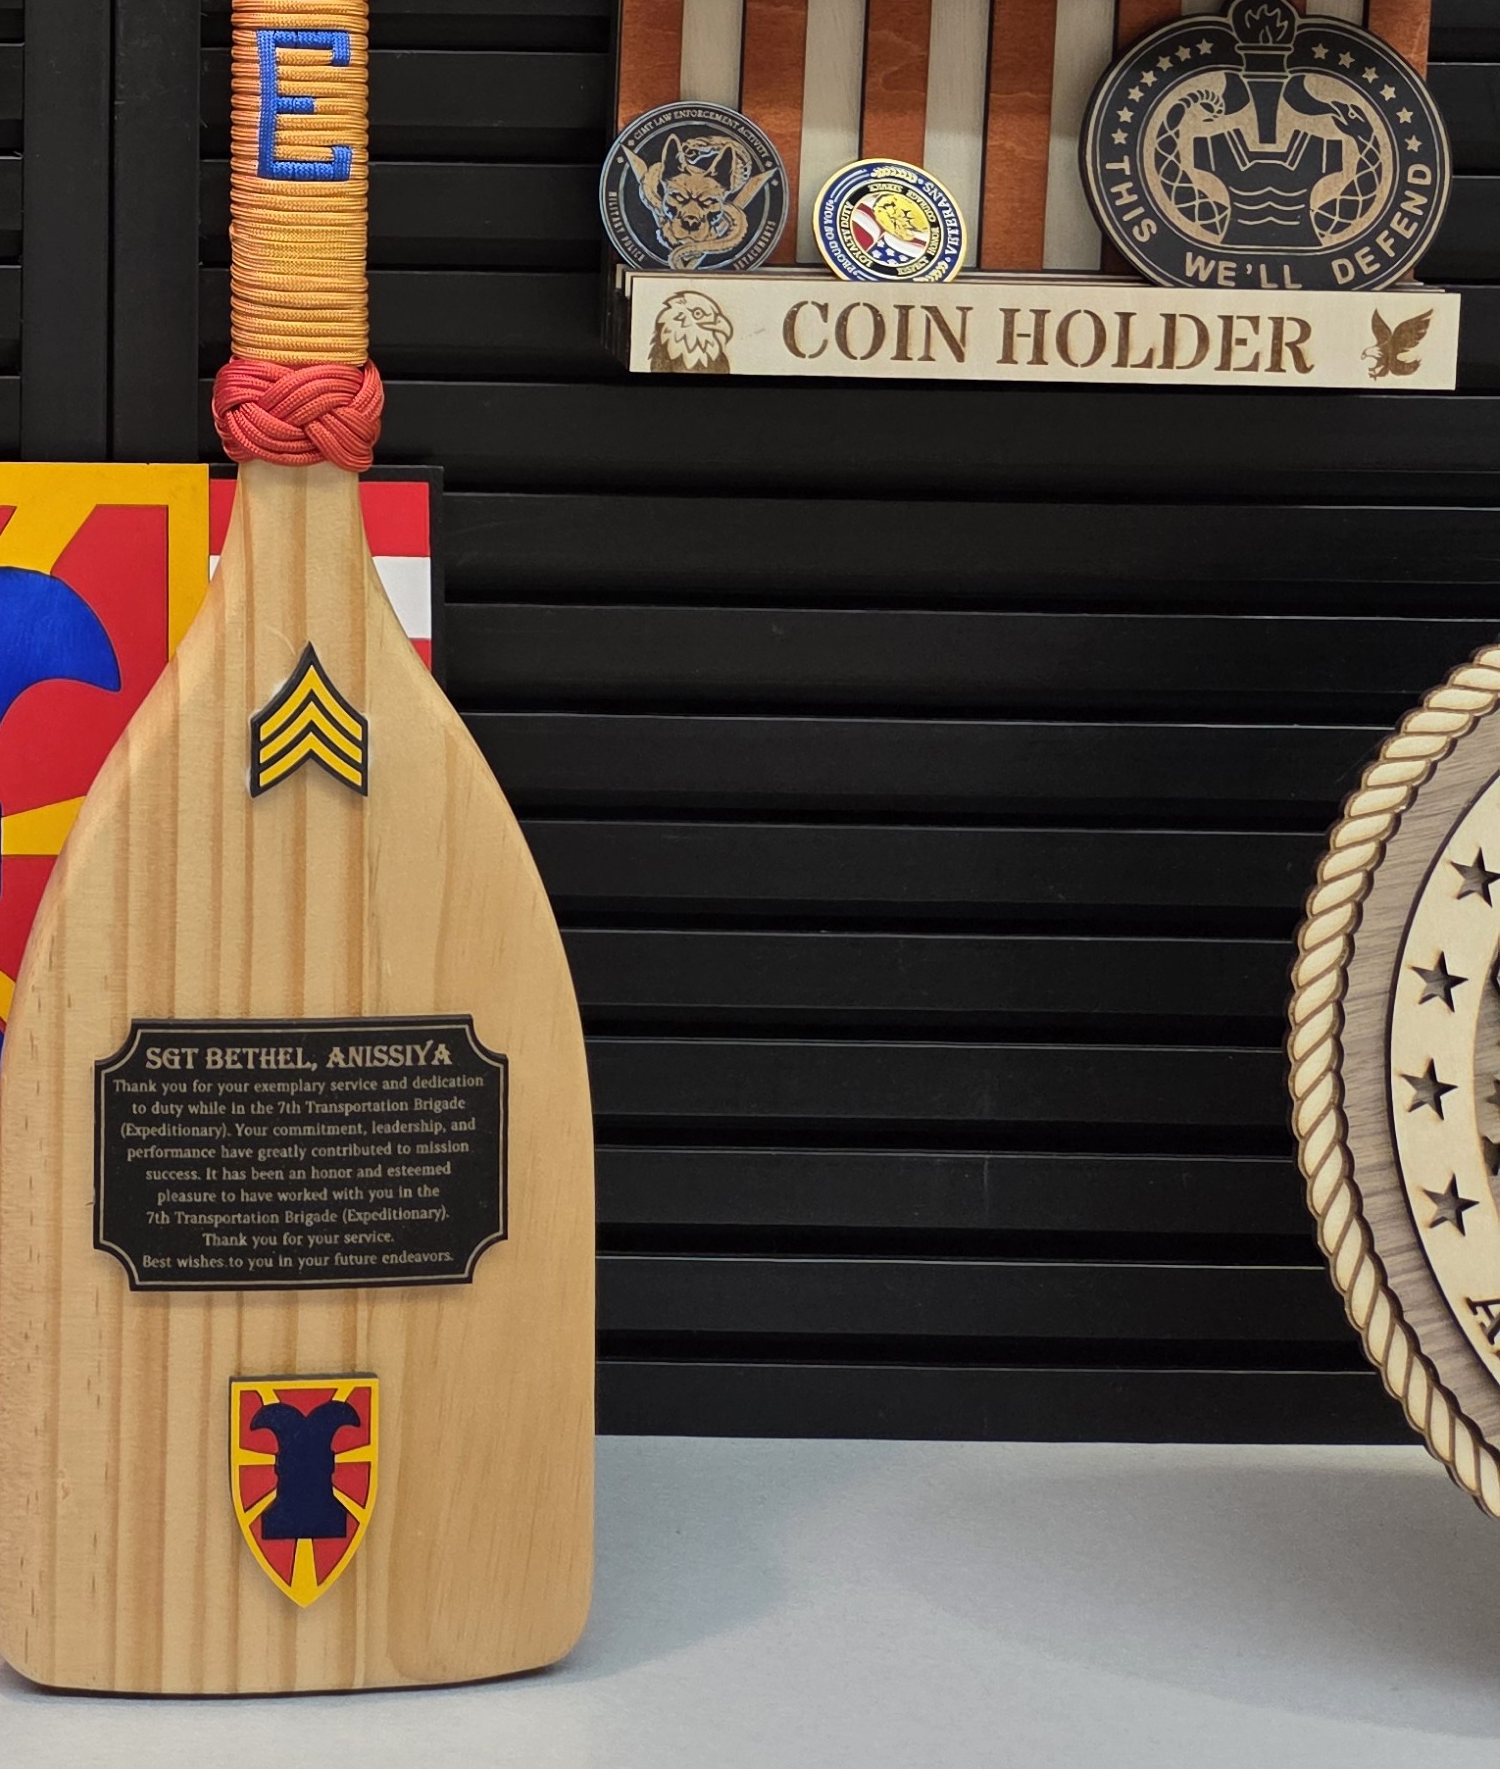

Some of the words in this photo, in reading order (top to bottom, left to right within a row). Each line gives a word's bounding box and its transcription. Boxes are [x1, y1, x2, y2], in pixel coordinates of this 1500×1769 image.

[654, 113, 672, 127] LAW
[673, 109, 739, 131] ENFORCEMENT
[738, 126, 771, 159] ACTIVITY
[1105, 155, 1158, 243] THIS
[1185, 252, 1302, 289] WE'LL
[1331, 163, 1432, 285] DEFEND
[783, 298, 974, 365] COIN
[997, 308, 1316, 375] HOLDER
[145, 1047, 200, 1070] SGT
[205, 1046, 318, 1072] BETHEL,
[325, 1040, 453, 1069] ANISSIYA
[112, 1078, 157, 1093] Thank
[161, 1082, 187, 1096] you
[192, 1079, 213, 1093] for
[217, 1082, 250, 1097] your
[253, 1078, 326, 1096] exemplary
[330, 1077, 378, 1092] service
[382, 1076, 408, 1090] and
[412, 1074, 484, 1089] dedication
[120, 1122, 232, 1141] (Expeditionary).
[234, 1122, 268, 1137] Your
[272, 1122, 368, 1137] commitment,
[371, 1119, 447, 1136] leadership,
[450, 1116, 476, 1132] and
[127, 1144, 217, 1162] performance
[220, 1144, 254, 1159] have
[257, 1144, 307, 1162] greatly
[311, 1141, 392, 1158] contributed
[397, 1143, 412, 1155] to
[416, 1139, 470, 1154] mission
[146, 1210, 170, 1225] 7th
[174, 1211, 280, 1228] Transportation
[284, 1208, 338, 1227] Brigade
[342, 1204, 450, 1226] (Expeditionary).
[142, 1254, 172, 1269] Best
[228, 1256, 244, 1268] to
[247, 1251, 275, 1271] you
[278, 1254, 293, 1267] in
[297, 1256, 330, 1271] your
[334, 1252, 378, 1266] future
[381, 1250, 454, 1265] endeavors.
